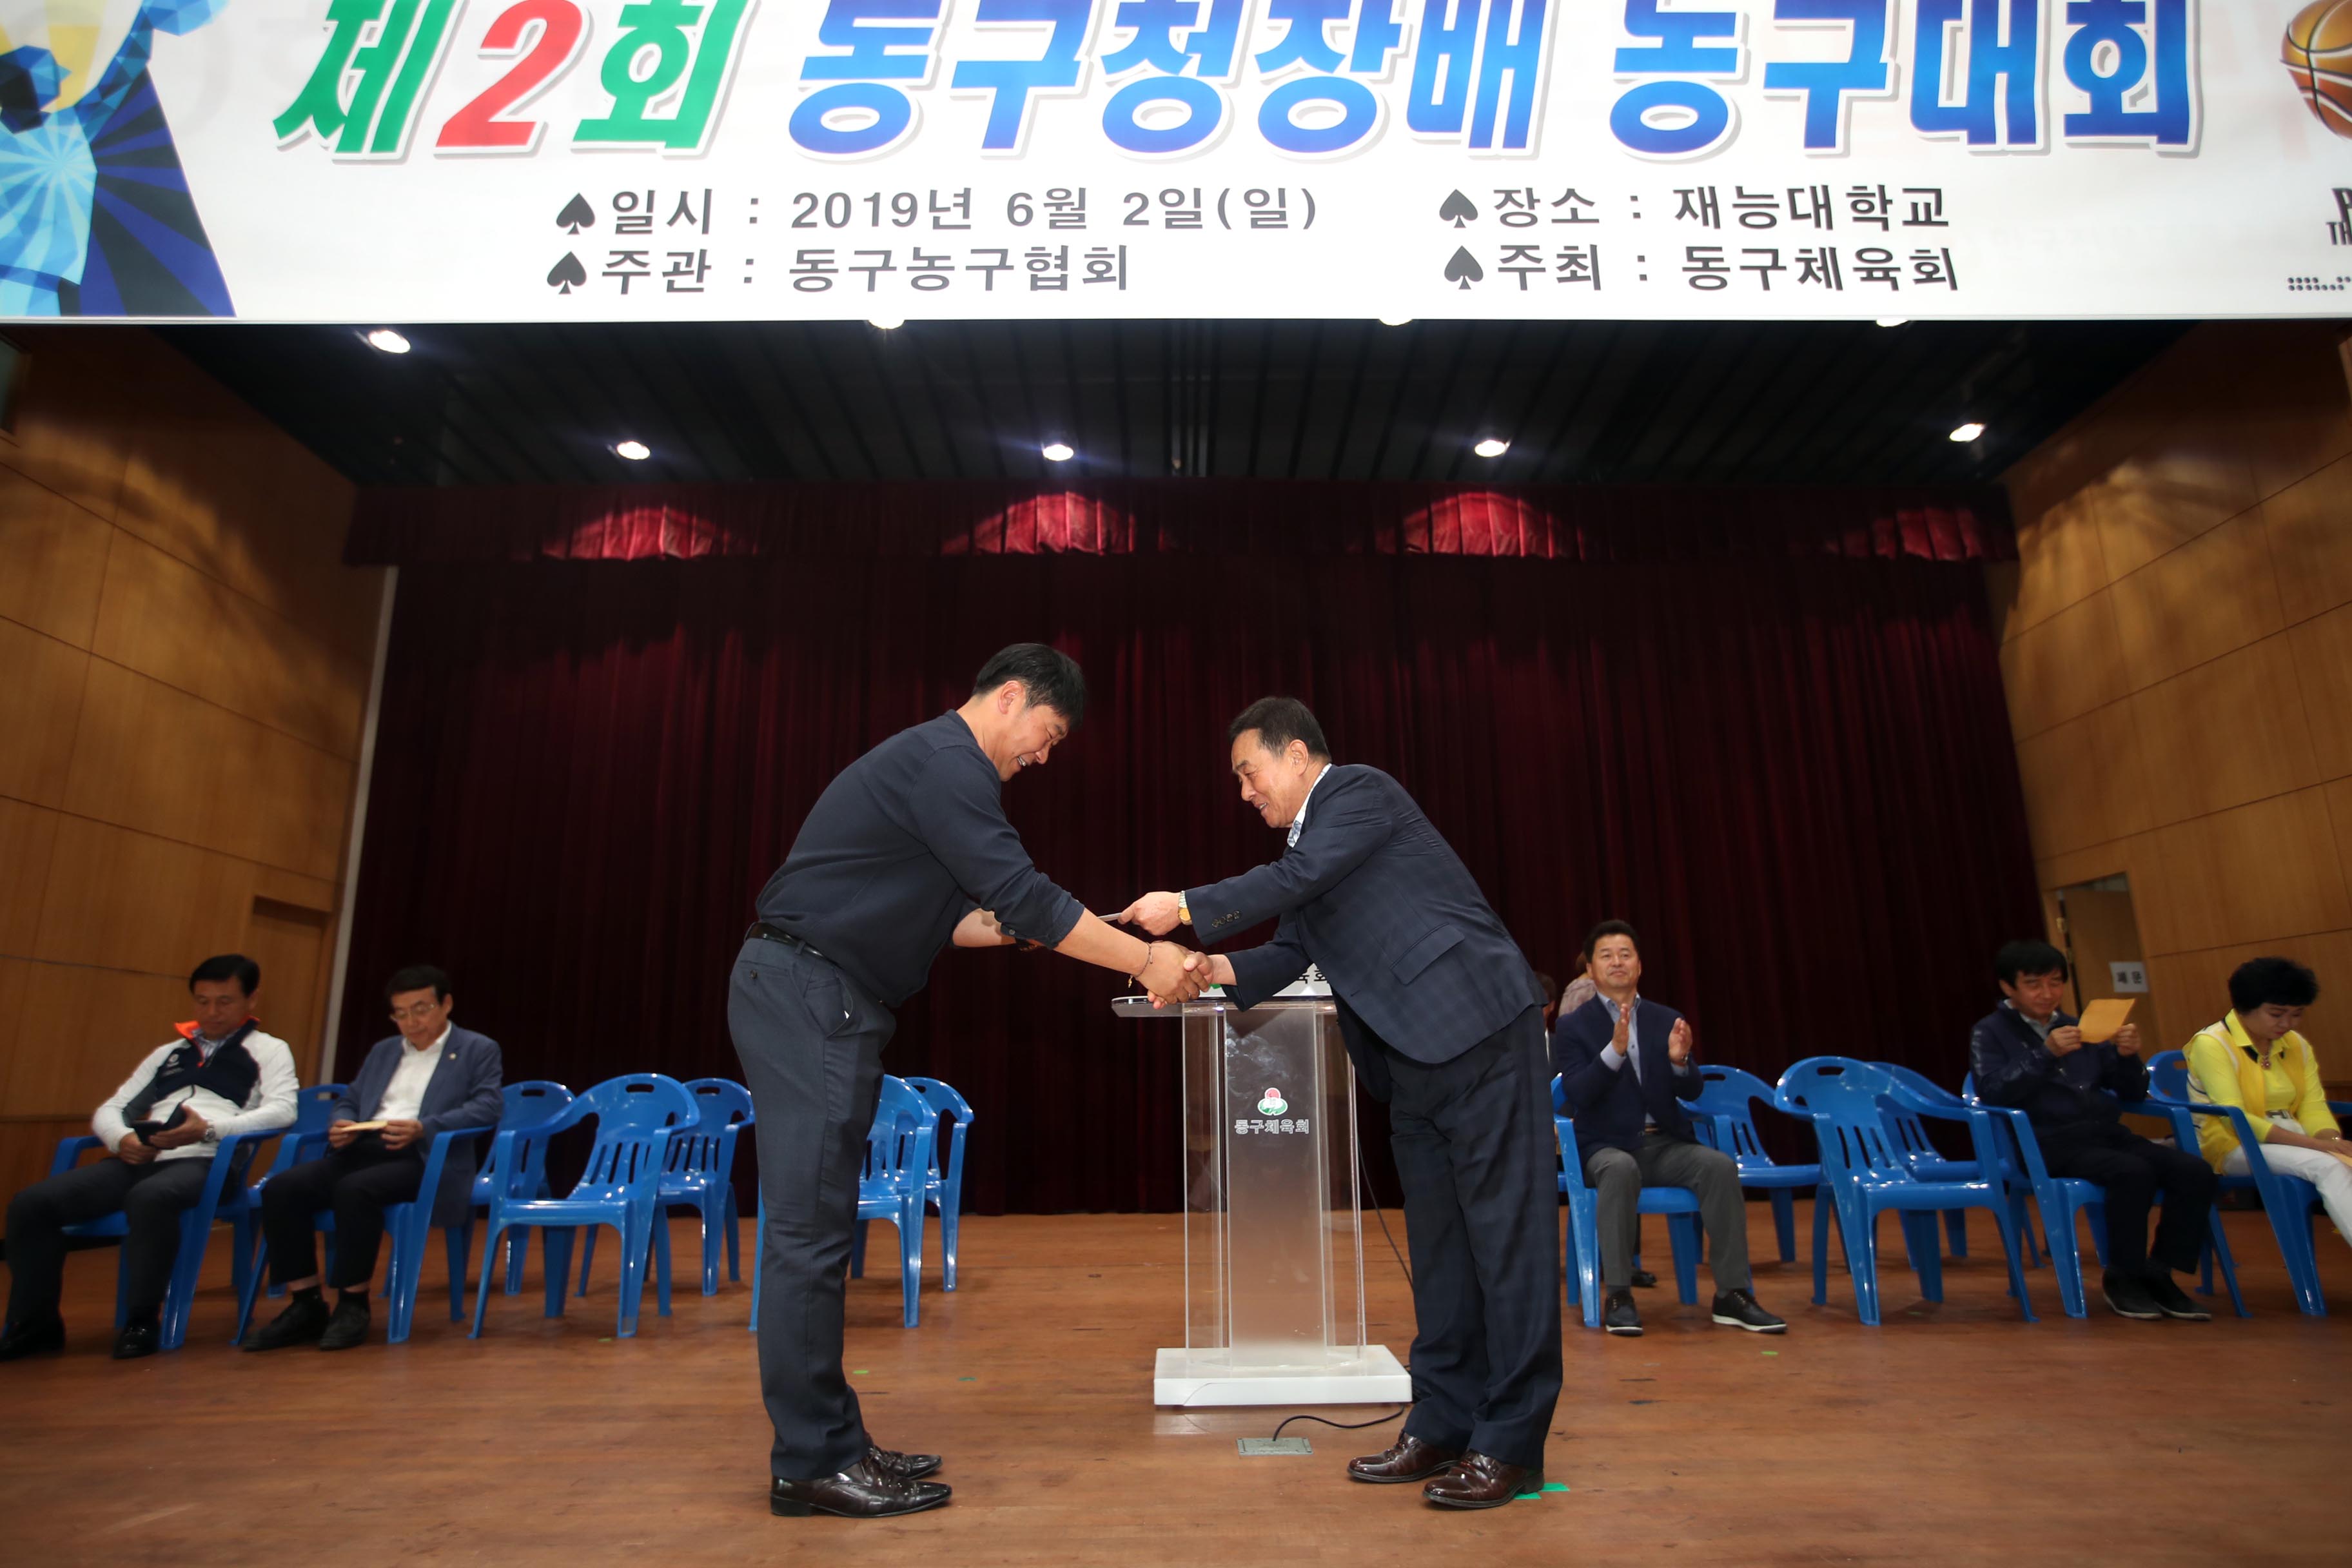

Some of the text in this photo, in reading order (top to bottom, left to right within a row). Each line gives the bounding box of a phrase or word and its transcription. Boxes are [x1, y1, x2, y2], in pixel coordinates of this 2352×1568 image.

[273, 0, 747, 153] 제2회
[789, 0, 1547, 153] 동구청장배
[612, 188, 712, 235] 일시
[791, 188, 973, 230] 2019년
[1006, 187, 1088, 230] 6월
[1122, 188, 1317, 230] 2일(일)
[1493, 187, 1600, 228] 장소
[1672, 184, 1950, 231] 재능대학교
[601, 248, 712, 295] 주관
[789, 244, 1128, 293] 동구농구협회
[1496, 244, 1602, 291] 주최
[1681, 245, 1959, 291] 동구체육회
[1234, 1119, 1309, 1135] 동구체육회
